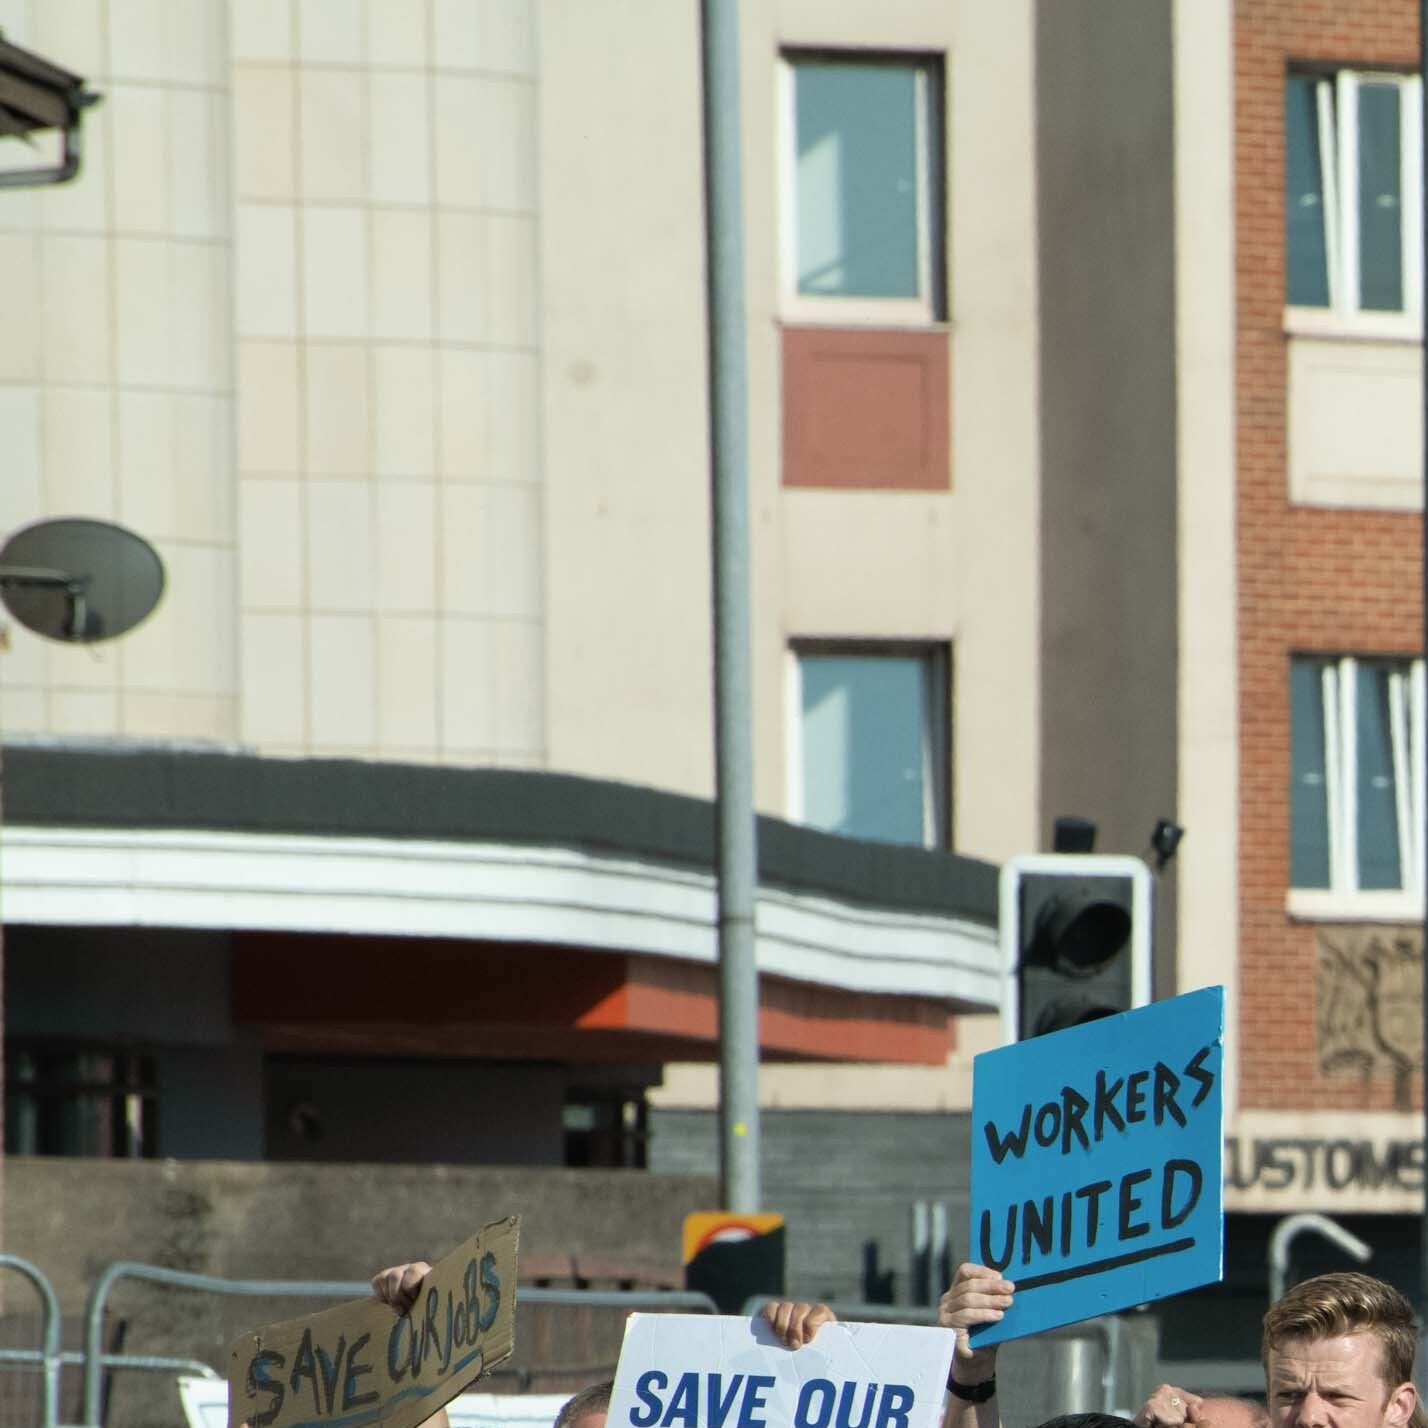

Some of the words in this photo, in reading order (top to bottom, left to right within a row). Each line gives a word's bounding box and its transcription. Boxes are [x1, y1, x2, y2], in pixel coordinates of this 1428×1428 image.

[984, 1038, 1222, 1165] WORKERS
[980, 1159, 1202, 1272] UNITED
[1226, 1137, 1426, 1190] USTOMS
[246, 1327, 380, 1426] SAVE
[388, 1286, 442, 1384] OUR
[438, 1251, 500, 1376] JOBS
